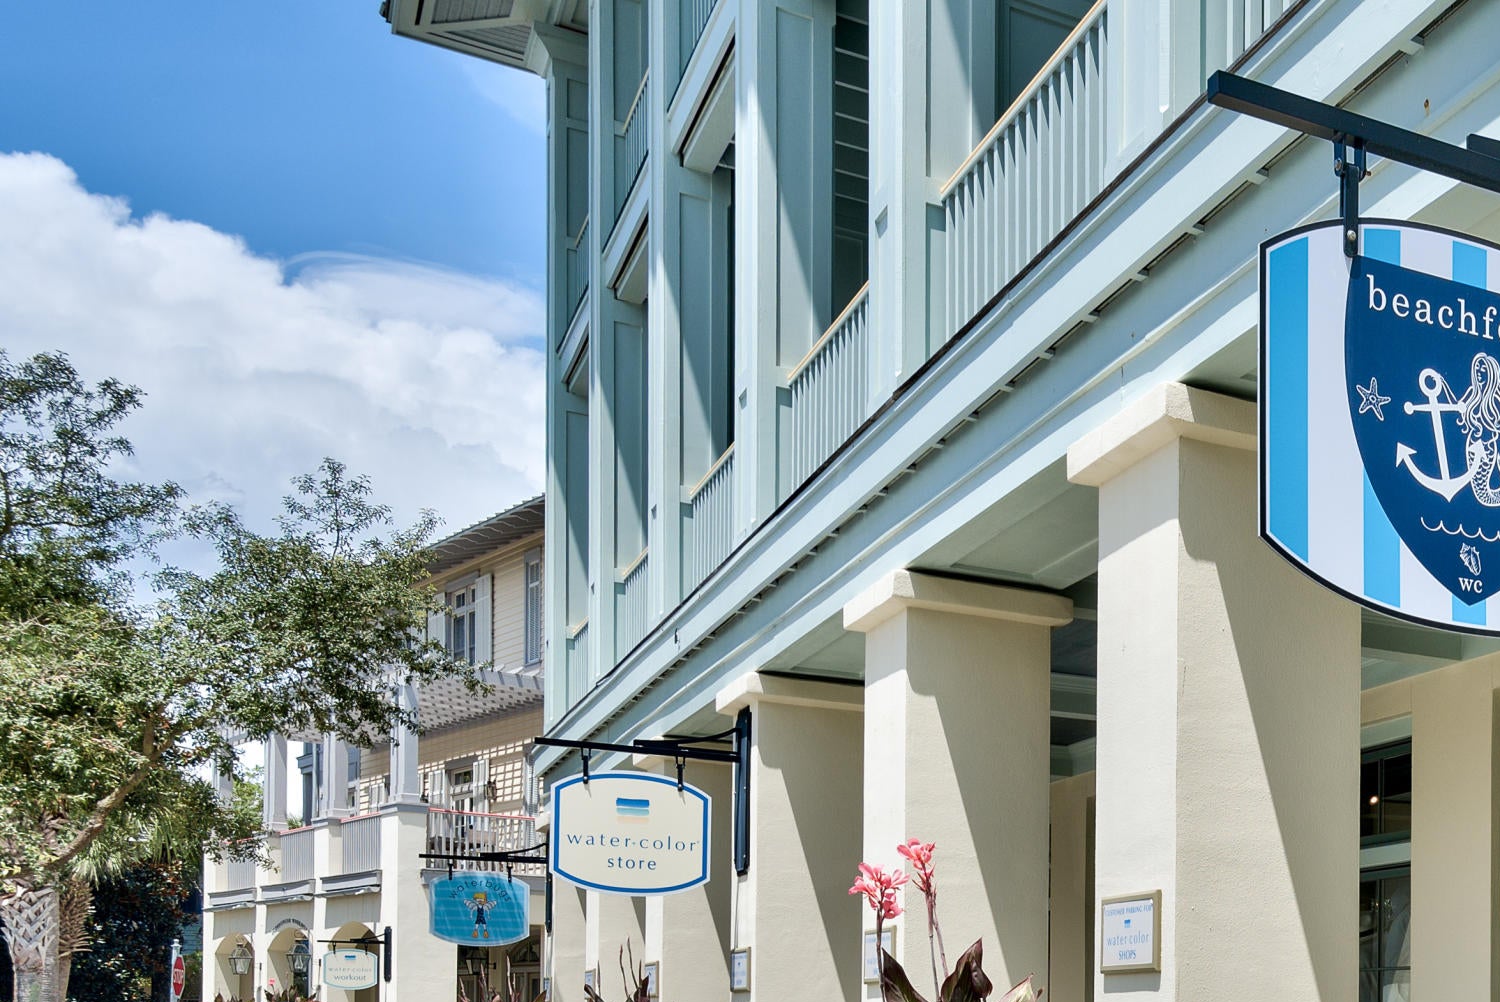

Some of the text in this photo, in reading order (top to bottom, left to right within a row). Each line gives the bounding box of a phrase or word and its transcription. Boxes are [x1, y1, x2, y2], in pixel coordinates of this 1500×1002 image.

[607, 856, 657, 870] store
[448, 880, 512, 902] waterbugs
[1118, 949, 1136, 961] SHOPS
